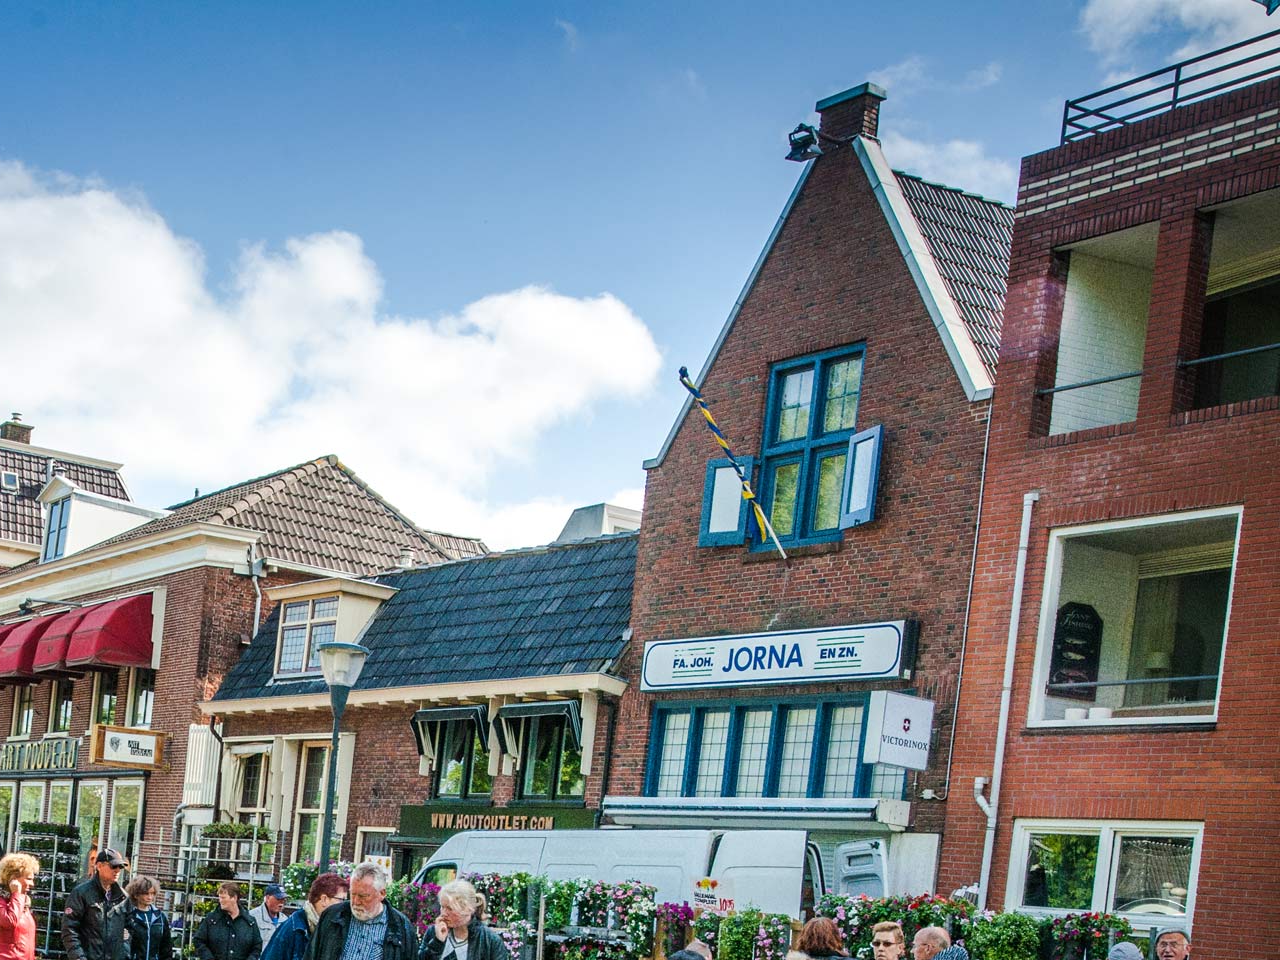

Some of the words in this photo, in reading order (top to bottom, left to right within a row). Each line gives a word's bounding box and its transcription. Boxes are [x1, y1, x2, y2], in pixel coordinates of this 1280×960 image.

[672, 658, 689, 669] FA.
[690, 657, 714, 668] JOH.
[722, 644, 803, 672] JORNA
[820, 648, 836, 659] EN
[838, 646, 858, 658] ZN.
[882, 735, 928, 751] VICTORINOX
[0, 744, 22, 770] ART
[431, 813, 554, 830] WWW.HOUTOUTLET.COM
